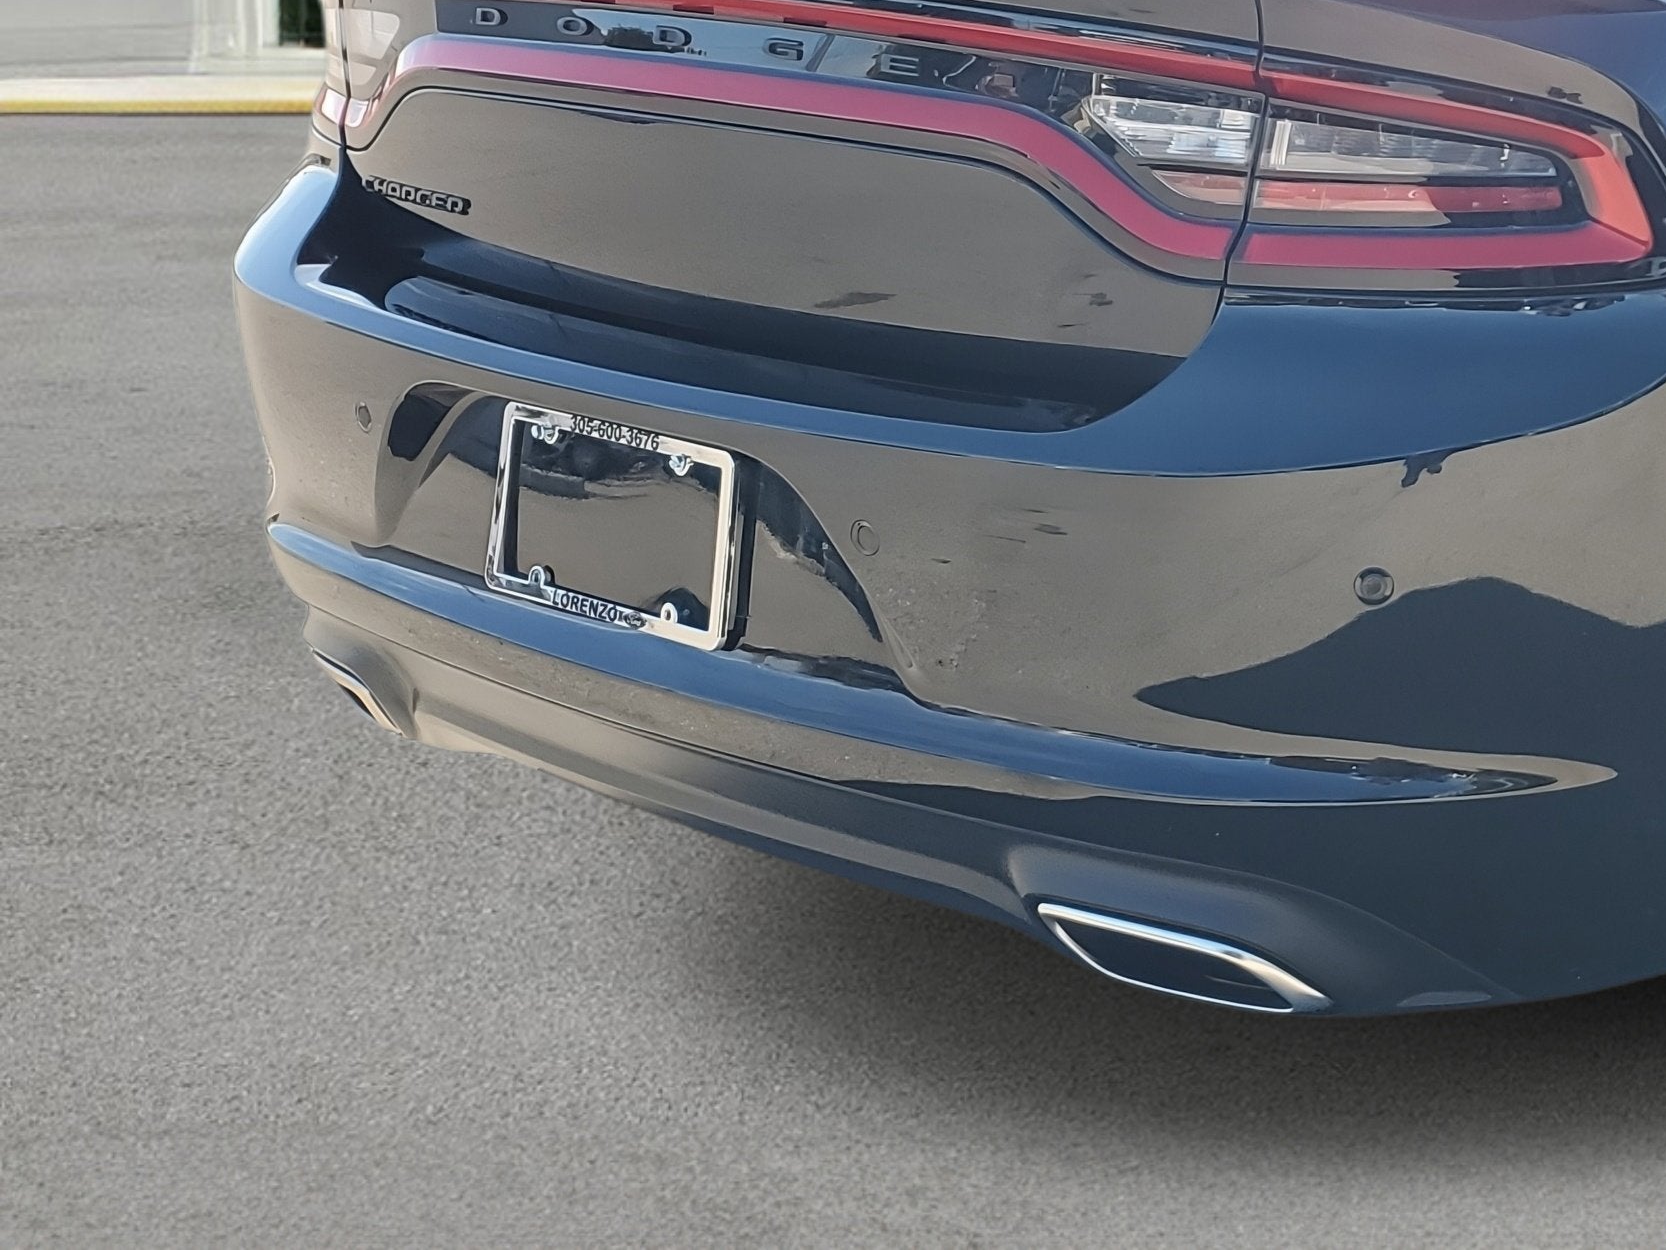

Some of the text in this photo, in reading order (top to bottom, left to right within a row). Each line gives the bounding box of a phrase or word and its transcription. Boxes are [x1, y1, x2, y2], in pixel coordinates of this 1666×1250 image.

[474, 6, 920, 77] DODGE
[361, 175, 466, 214] CHARGER
[570, 414, 660, 451] 305-600-3676
[552, 589, 618, 623] LORENZO
